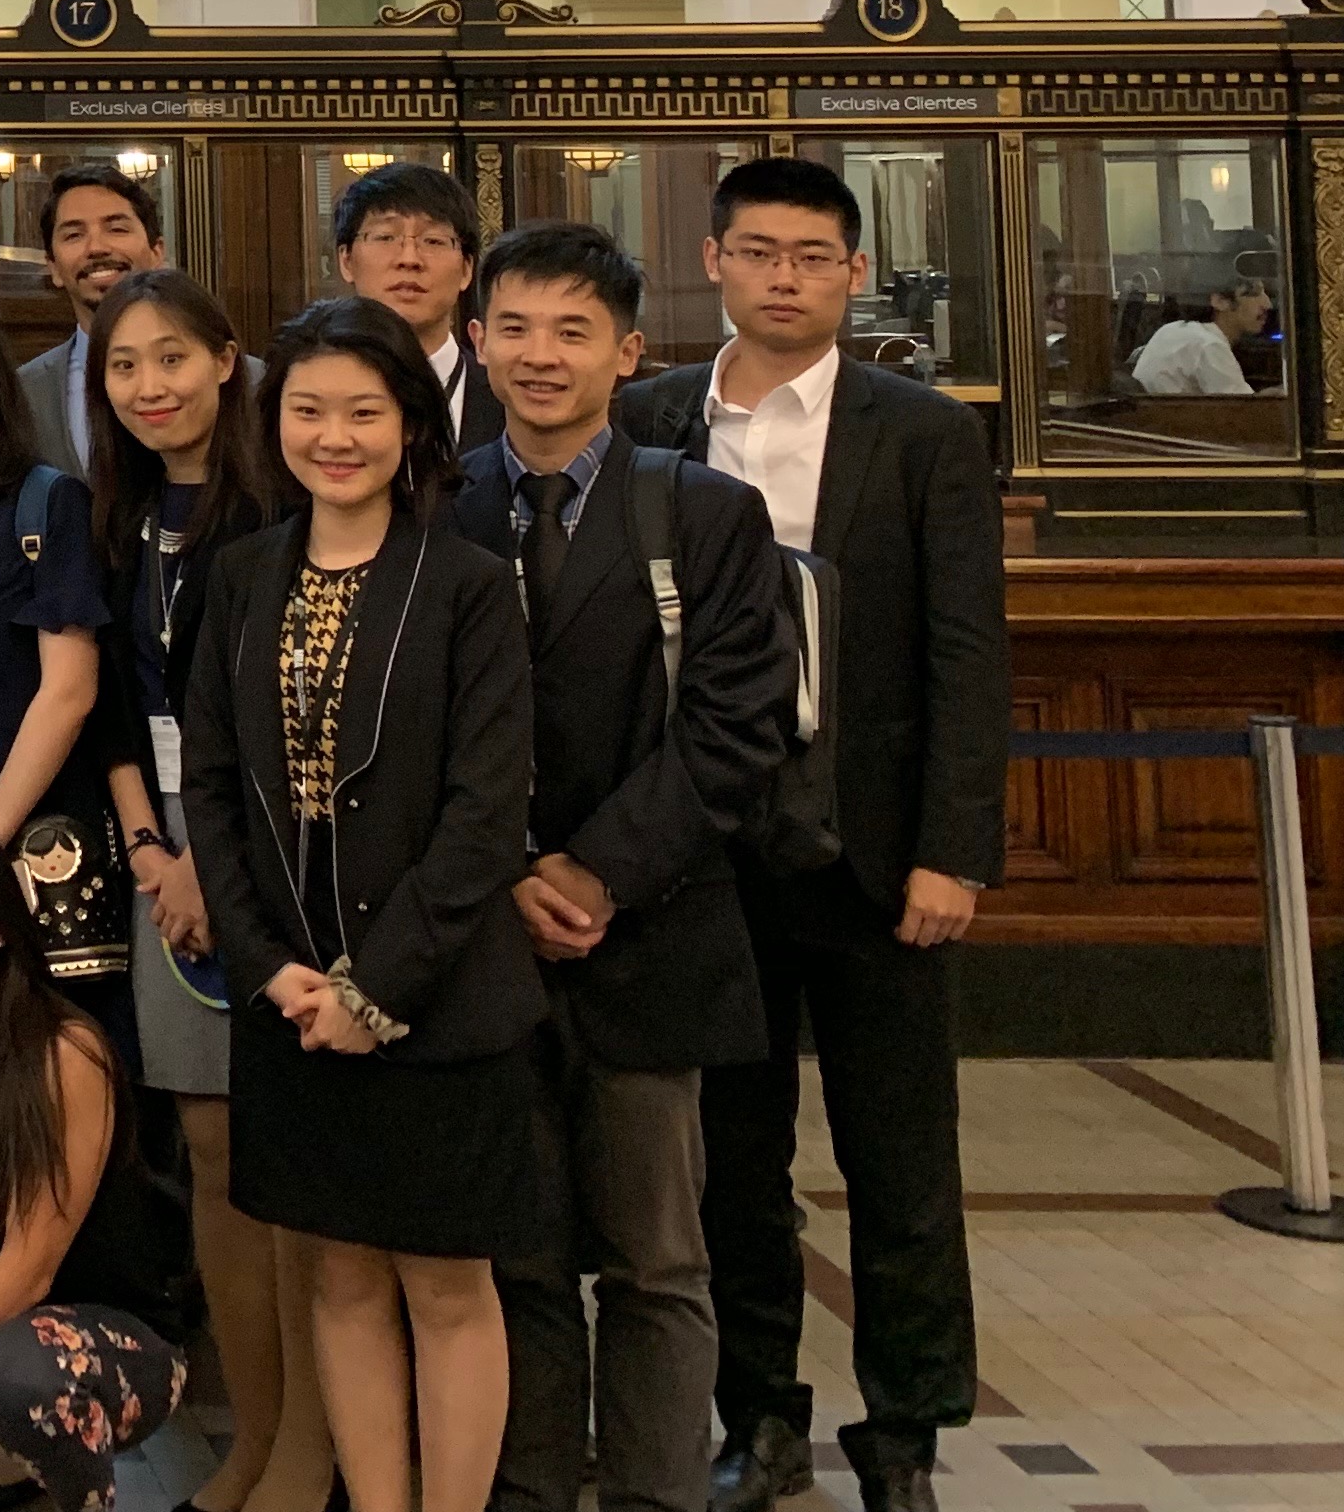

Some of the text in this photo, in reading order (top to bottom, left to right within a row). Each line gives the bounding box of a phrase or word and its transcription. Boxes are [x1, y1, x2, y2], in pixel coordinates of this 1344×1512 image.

[68, 1, 96, 26] 17
[69, 100, 224, 116] Exclusiva Clientes
[821, 95, 978, 112] Exclusiva Clientes
